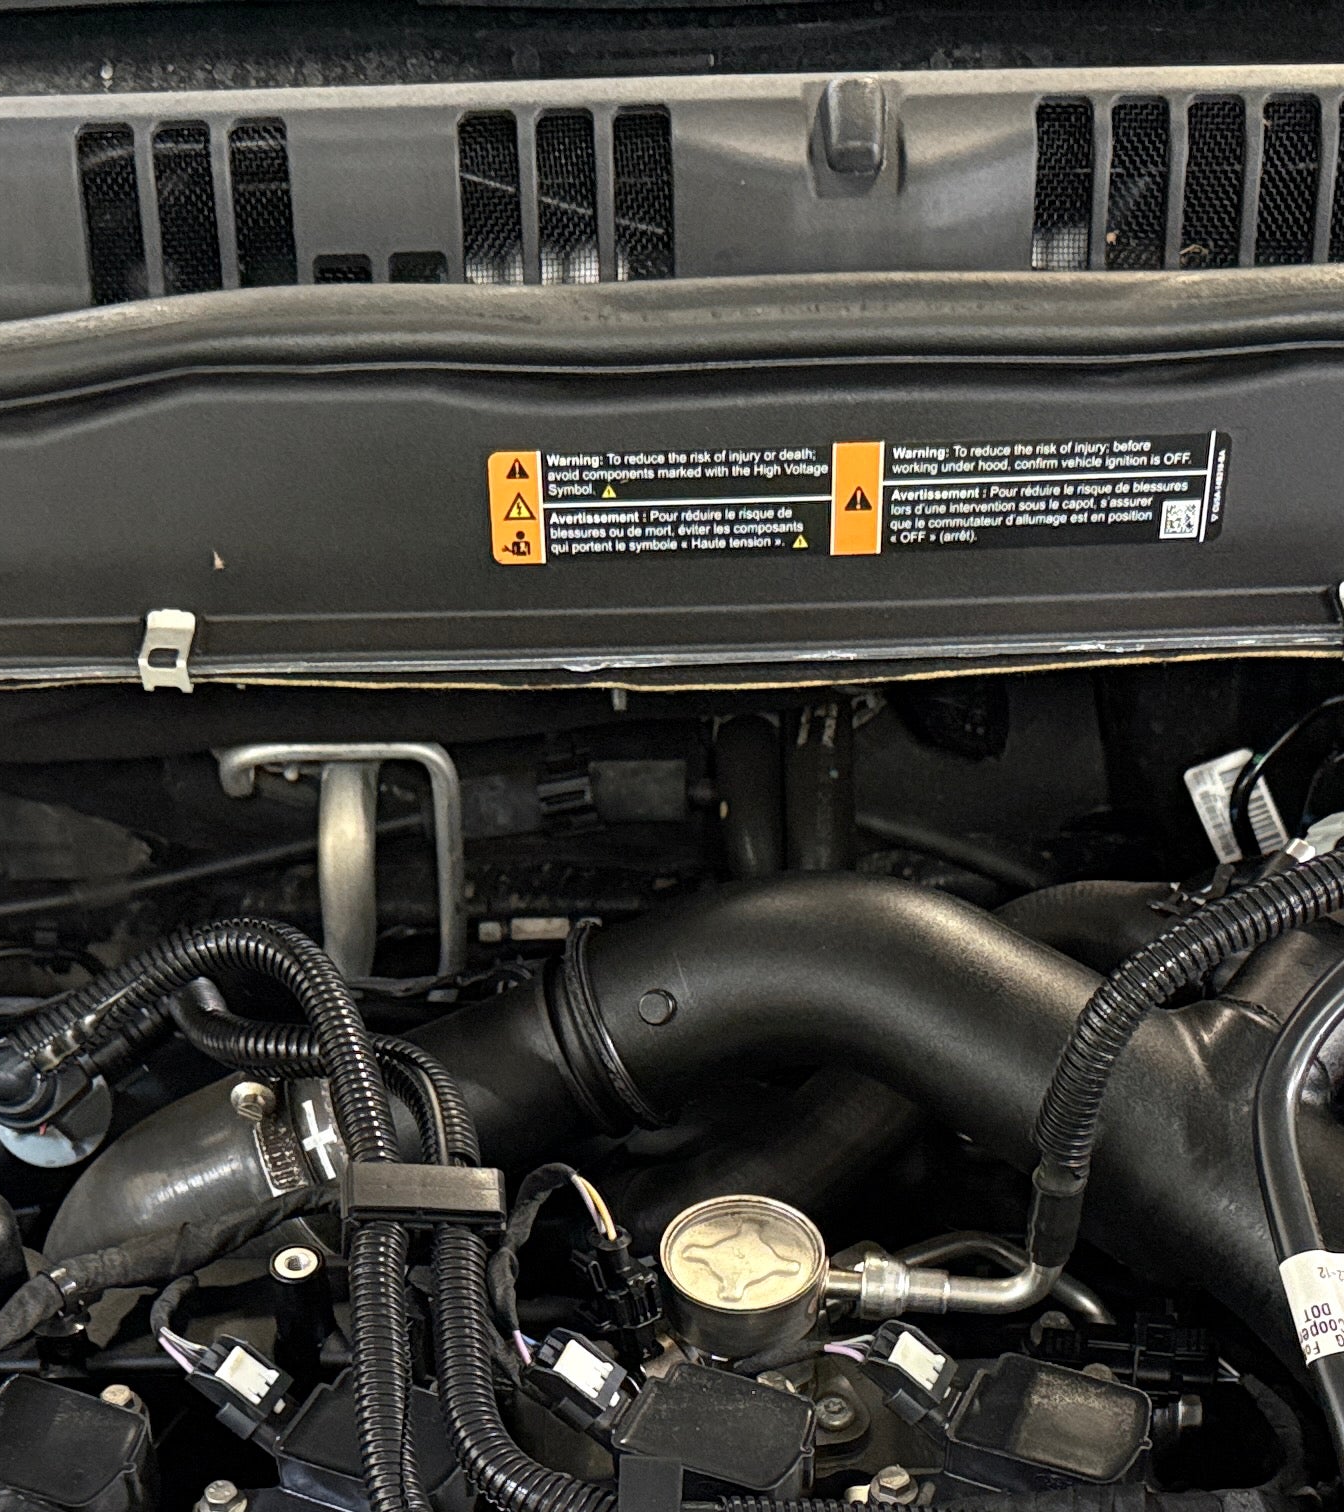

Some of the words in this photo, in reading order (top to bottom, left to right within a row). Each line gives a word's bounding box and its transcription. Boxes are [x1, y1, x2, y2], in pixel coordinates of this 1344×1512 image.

[547, 453, 604, 468] Warning:
[606, 453, 621, 465] To
[624, 453, 665, 464] reduce
[668, 452, 687, 464] the
[690, 451, 711, 463] risk
[714, 450, 726, 462] of
[728, 450, 761, 464] injury
[764, 451, 776, 460] or
[893, 447, 950, 461] Warning:
[953, 445, 967, 457] To
[970, 445, 1011, 457] reduce
[1014, 444, 1032, 455] the
[1035, 442, 1056, 455] risk
[1060, 440, 1072, 454] of
[1113, 440, 1151, 452] before
[547, 469, 579, 481] avoid
[582, 468, 654, 482] components
[658, 466, 701, 479] marked
[705, 466, 728, 477] with
[732, 466, 750, 477] the
[754, 464, 781, 478] High
[784, 463, 828, 477] Voltage
[892, 462, 938, 475] working
[941, 460, 975, 473] under
[978, 459, 1011, 472] hood,
[1014, 457, 1058, 470] confirm
[1061, 456, 1102, 468] vehicle
[1106, 454, 1147, 469] ignition
[1150, 454, 1160, 465] is
[1163, 452, 1192, 465] OFF.
[891, 489, 980, 501] Avertissement
[990, 486, 1018, 498] Pour
[1020, 484, 1061, 497] réduire
[1064, 484, 1074, 494] le
[1077, 483, 1112, 496] risque
[1115, 482, 1130, 493] de
[1133, 481, 1188, 492] blessures
[550, 511, 639, 524] Avertissement
[650, 510, 678, 522] Pour
[681, 509, 722, 522] réduire
[725, 508, 735, 519] le
[739, 507, 774, 521] risque
[777, 507, 793, 519] de
[891, 504, 912, 516] lors
[915, 503, 946, 514] d'une
[949, 501, 1015, 514] intervention
[1018, 501, 1046, 511] sous
[1049, 499, 1059, 510] le
[1062, 497, 1097, 511] capot,
[1100, 496, 1153, 508] s'assurer
[550, 527, 606, 539] blessures
[609, 528, 624, 538] ou
[627, 526, 642, 537] de
[645, 525, 675, 537] mort,
[678, 523, 711, 536] éviter
[713, 523, 730, 535] les
[734, 521, 803, 535] composants
[890, 520, 912, 532] que
[915, 518, 925, 529] le
[928, 516, 1003, 528] commutateur
[1006, 513, 1067, 527] d'allumage
[1070, 512, 1088, 523] est
[1091, 513, 1105, 522] en
[1108, 511, 1152, 524] position
[551, 541, 569, 556] qui
[571, 541, 612, 555] portent
[616, 540, 626, 551] le
[629, 539, 678, 553] symbole
[692, 537, 726, 549] Haute
[729, 536, 771, 548] tension
[900, 531, 926, 543] OFF
[1304, 1302, 1331, 1323] DOT
